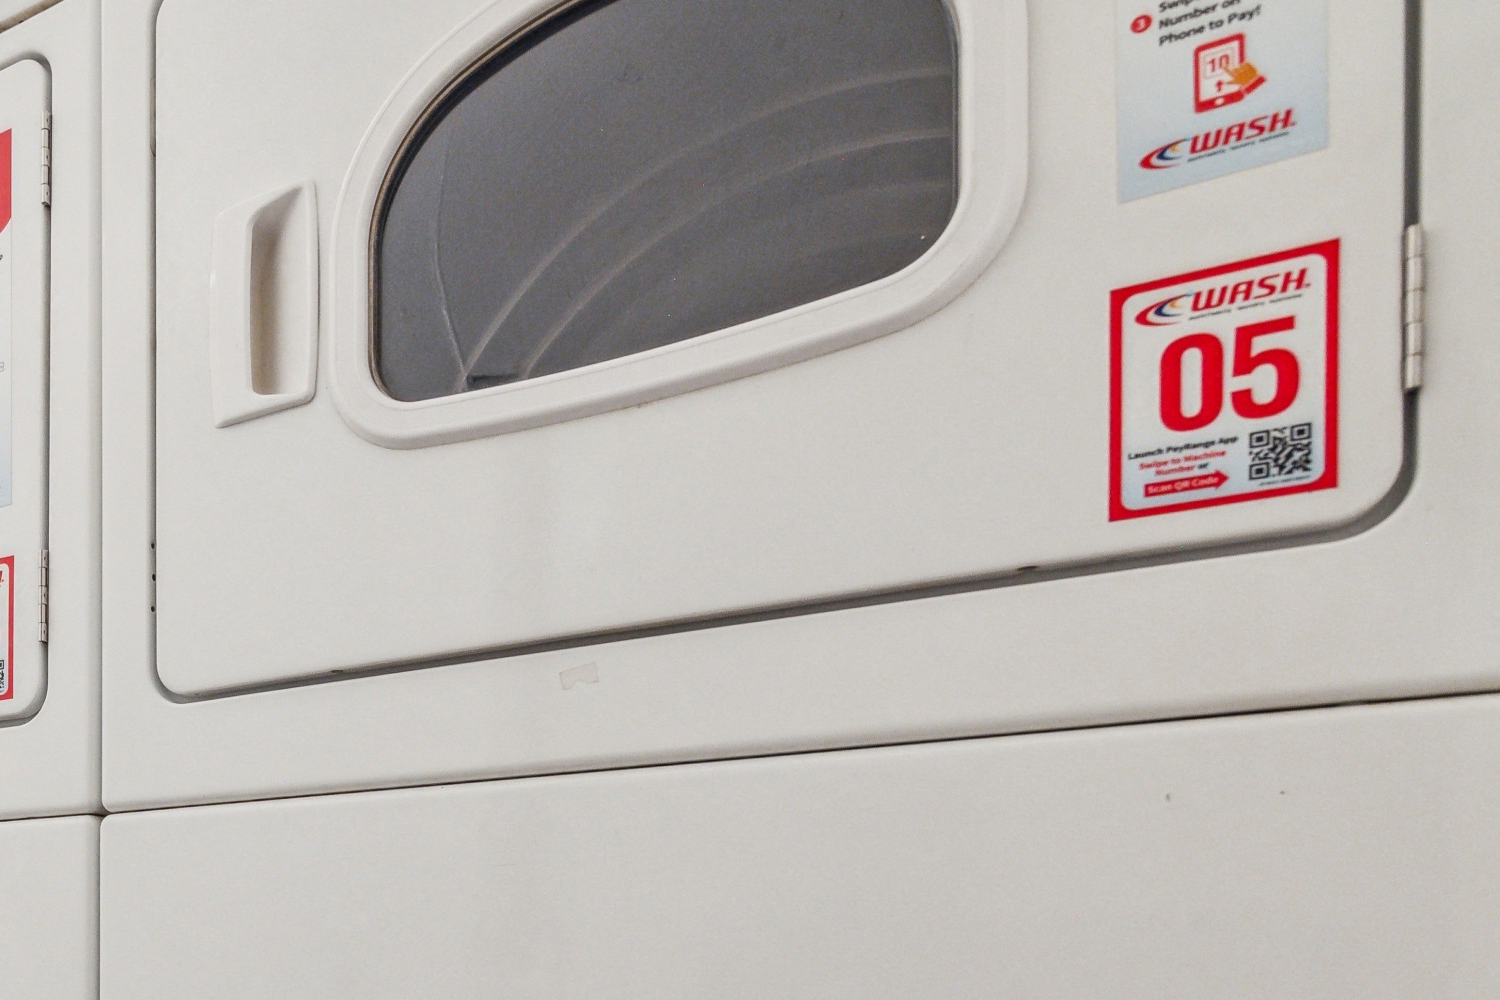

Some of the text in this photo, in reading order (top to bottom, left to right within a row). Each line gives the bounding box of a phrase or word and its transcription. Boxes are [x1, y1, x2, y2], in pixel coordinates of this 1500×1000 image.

[1159, 5, 1218, 29] Number
[1159, 5, 1261, 46] Phone to Pay!
[1208, 54, 1229, 73] 10
[1159, 316, 1300, 431] 05
[1128, 436, 1239, 460] Launch PayRange App
[1139, 450, 1226, 471] Swipe to Machine
[1155, 462, 1209, 476] Number or
[1147, 476, 1219, 495] Scan QR Code
